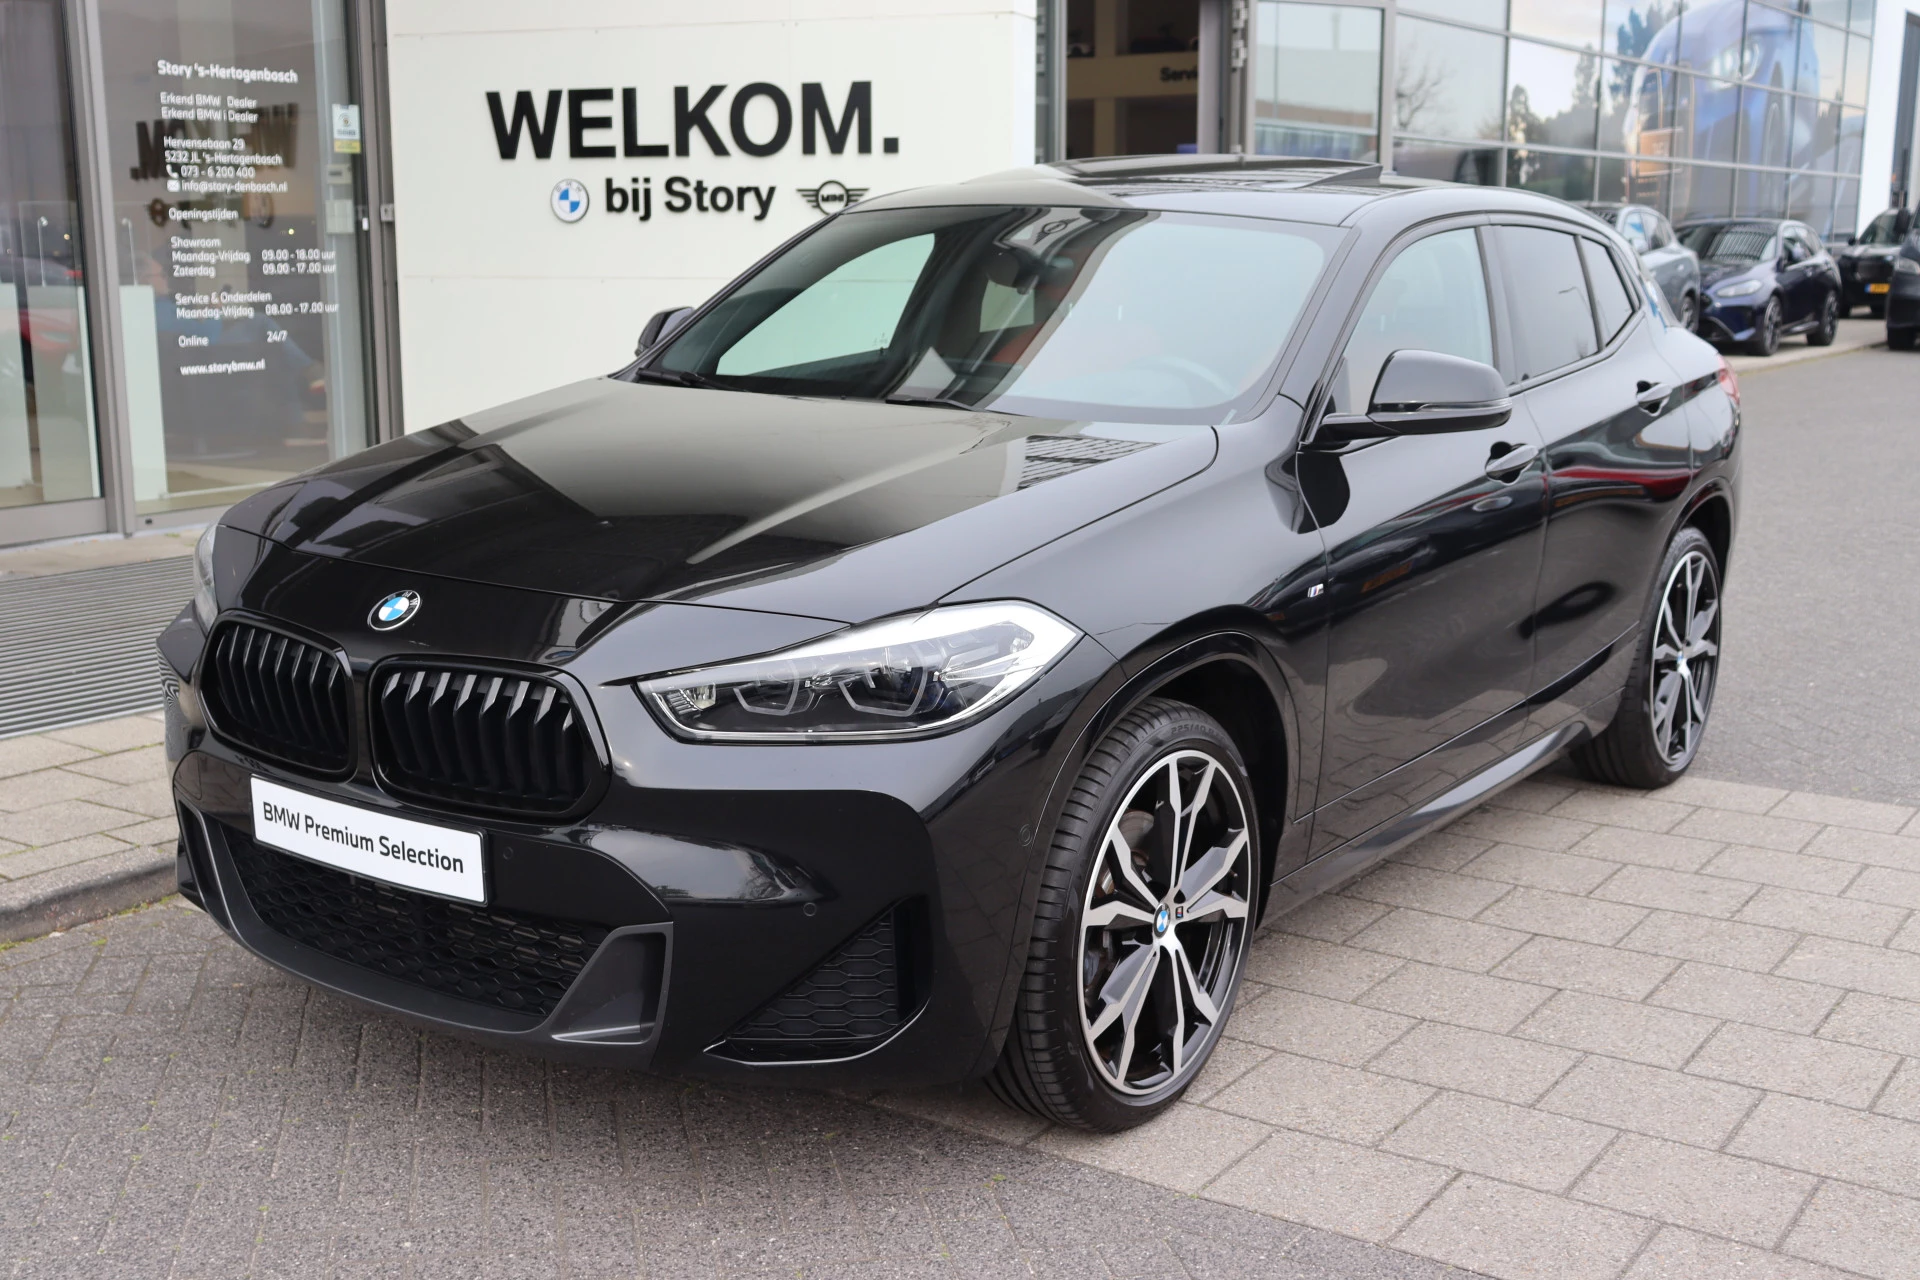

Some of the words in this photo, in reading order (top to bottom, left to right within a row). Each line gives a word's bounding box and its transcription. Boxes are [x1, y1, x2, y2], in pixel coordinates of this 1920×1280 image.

[157, 60, 193, 79] Story
[194, 62, 298, 83] 's-Hertogenbosch
[160, 92, 194, 105] Erkend
[195, 94, 221, 106] BMW
[226, 96, 257, 108] Dealer
[161, 107, 195, 119] Erkend
[196, 108, 221, 120] BMW
[227, 110, 258, 123] Dealer
[485, 80, 899, 160] WELKOM.
[163, 136, 231, 149] Hervensebaan
[232, 138, 245, 150] 29
[164, 150, 189, 163] 5232
[190, 151, 201, 163] JL
[181, 165, 199, 178] 073
[207, 166, 215, 178] 6
[215, 166, 235, 178] 200
[236, 167, 255, 178] 400
[181, 180, 288, 194] info@story-denbosch.nl
[605, 177, 652, 221] bij
[664, 176, 776, 221] Story
[168, 207, 238, 222] Openingstijden
[170, 236, 221, 249] Showroom
[172, 250, 251, 264] Maandag-Vrijdag
[261, 249, 289, 261] 09.00
[295, 248, 320, 260] 18.00
[321, 251, 336, 260] uur
[172, 264, 216, 278] Zaterdag
[262, 262, 290, 275] 09.00
[296, 262, 321, 274] 17.00
[322, 264, 337, 273] uur
[175, 292, 209, 306] Service
[210, 291, 220, 304] &
[220, 291, 272, 303] Onderdelen
[176, 305, 254, 320] Maandag-Vrijdag
[265, 303, 293, 315] 08.00
[299, 302, 324, 314] 17.00
[325, 303, 339, 313] uur
[178, 335, 209, 347] Online
[266, 330, 288, 343] 24/7
[180, 358, 266, 375] www.storybmw.nl
[263, 801, 300, 831] BMW
[304, 814, 374, 854] Premium
[379, 835, 464, 874] Selection
